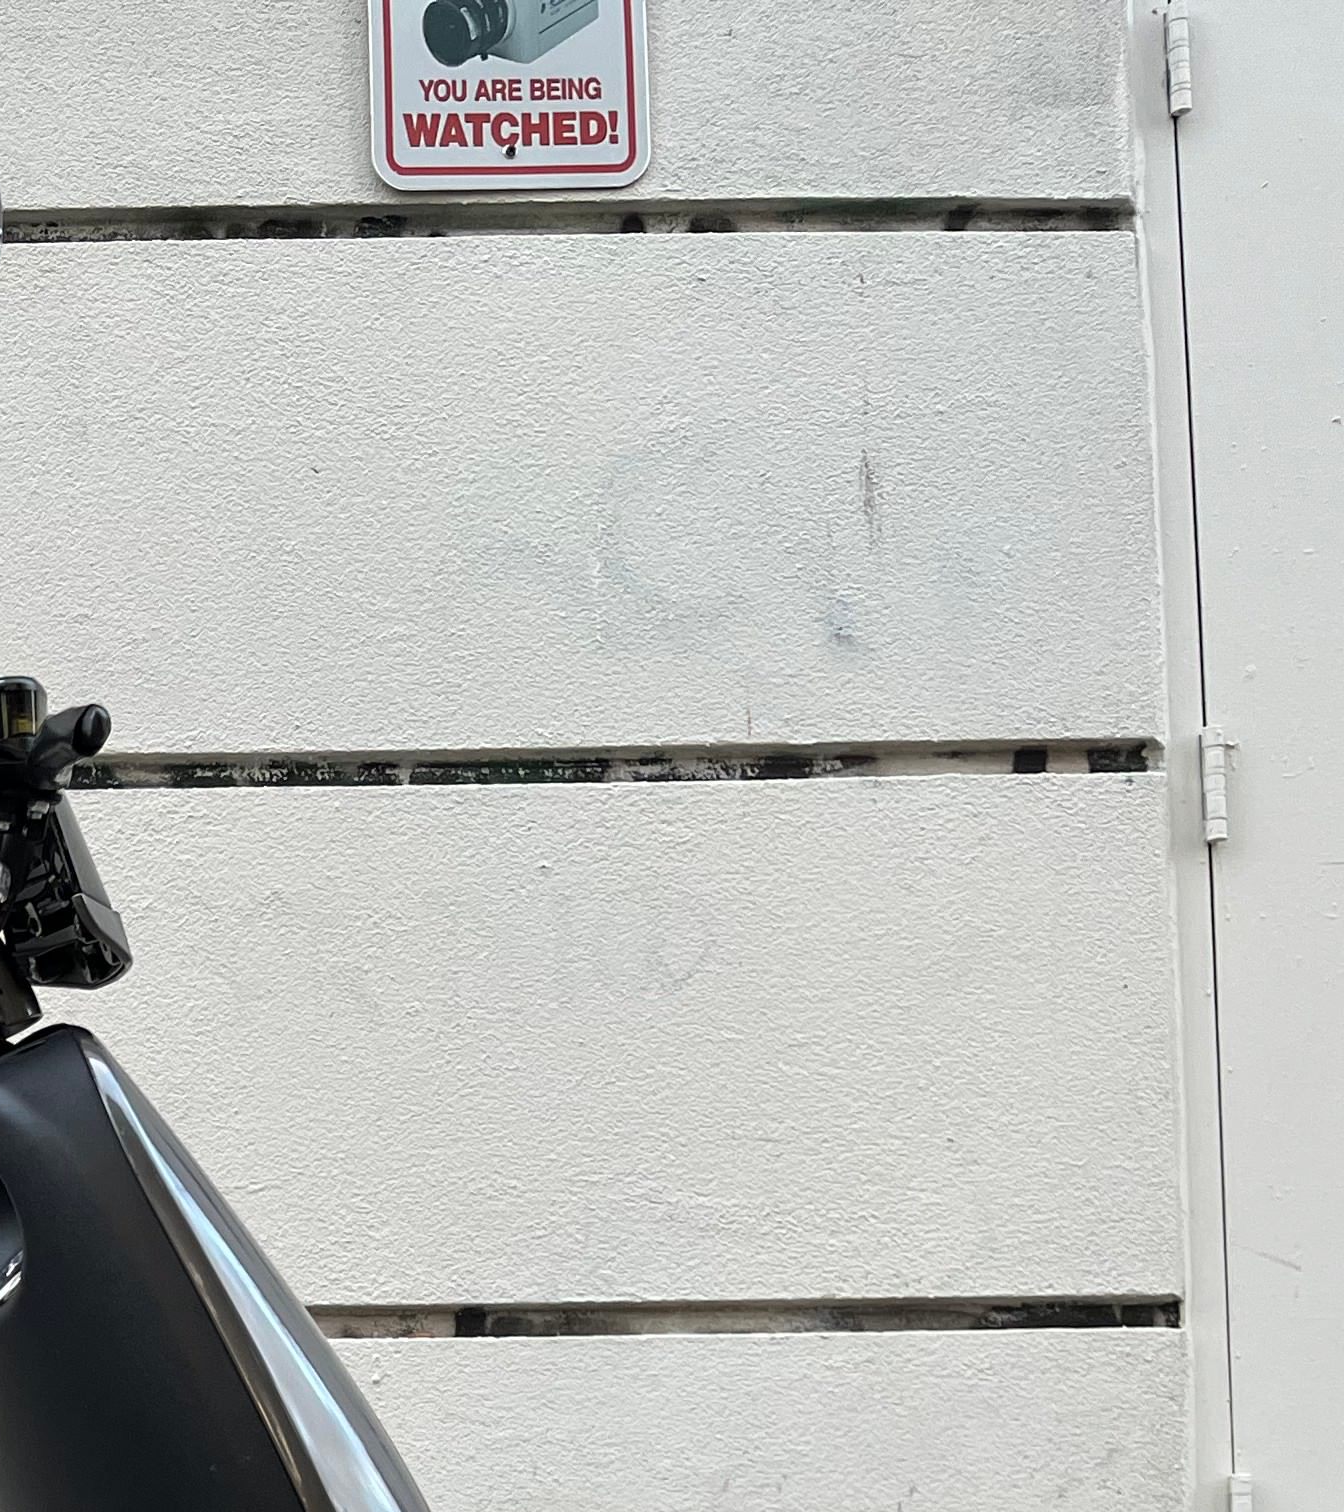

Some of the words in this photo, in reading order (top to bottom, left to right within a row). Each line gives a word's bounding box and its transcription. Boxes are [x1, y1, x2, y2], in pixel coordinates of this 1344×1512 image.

[418, 79, 468, 102] YOU
[474, 78, 522, 102] ARE
[529, 76, 602, 101] BEING
[402, 111, 619, 147] WATCHED!
